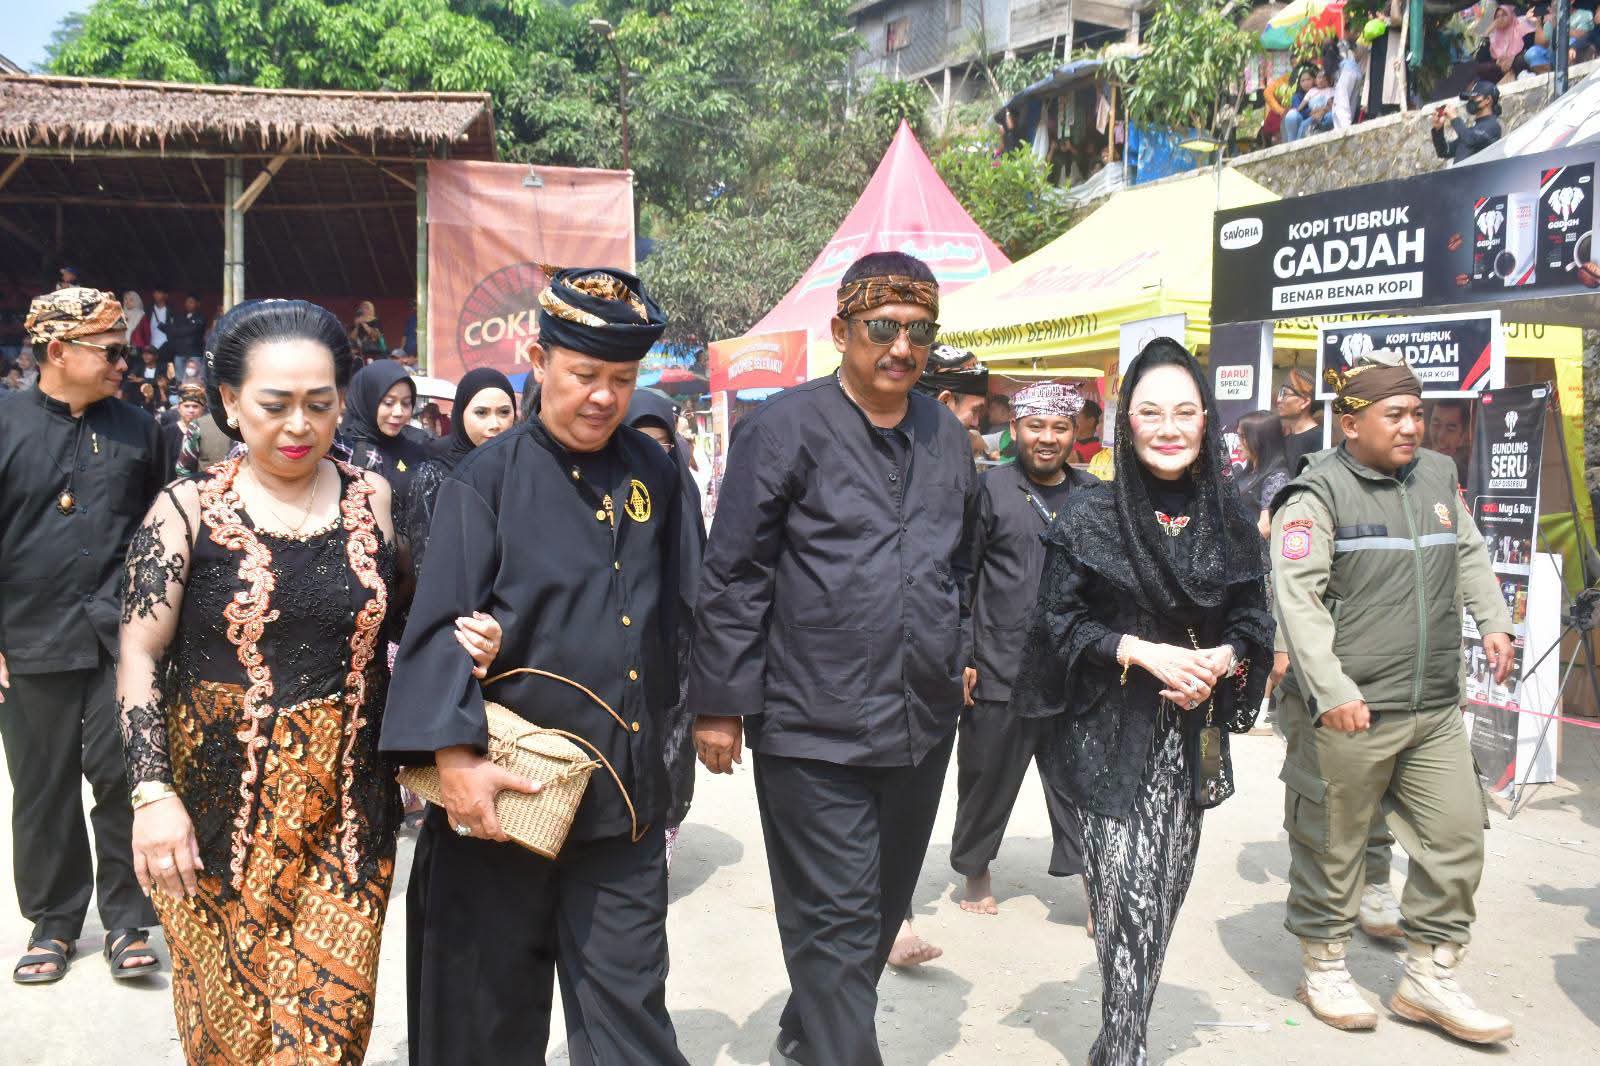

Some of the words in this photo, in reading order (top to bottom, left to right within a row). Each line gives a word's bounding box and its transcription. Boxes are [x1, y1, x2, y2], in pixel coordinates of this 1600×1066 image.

[1288, 218, 1329, 240] KOPI
[1333, 206, 1410, 233] TUBRUK
[1223, 225, 1260, 241] SAVORIA
[1273, 228, 1425, 279] GADJAH
[1280, 288, 1324, 303] BENAR
[1327, 283, 1374, 299] BENAR
[1378, 279, 1413, 294] KOPI
[464, 309, 540, 346] COKL
[938, 330, 984, 348] ORENG
[984, 323, 1024, 346] SAWIT
[1386, 333, 1409, 344] KOPI
[1411, 331, 1452, 342] TUBRUK
[1220, 369, 1249, 379] BARU!
[1435, 370, 1455, 379] KOPI
[1220, 380, 1249, 388] SPECIAL
[1492, 442, 1528, 455] BUNDLING
[1491, 455, 1528, 478] SERU
[1498, 503, 1514, 516] Mug
